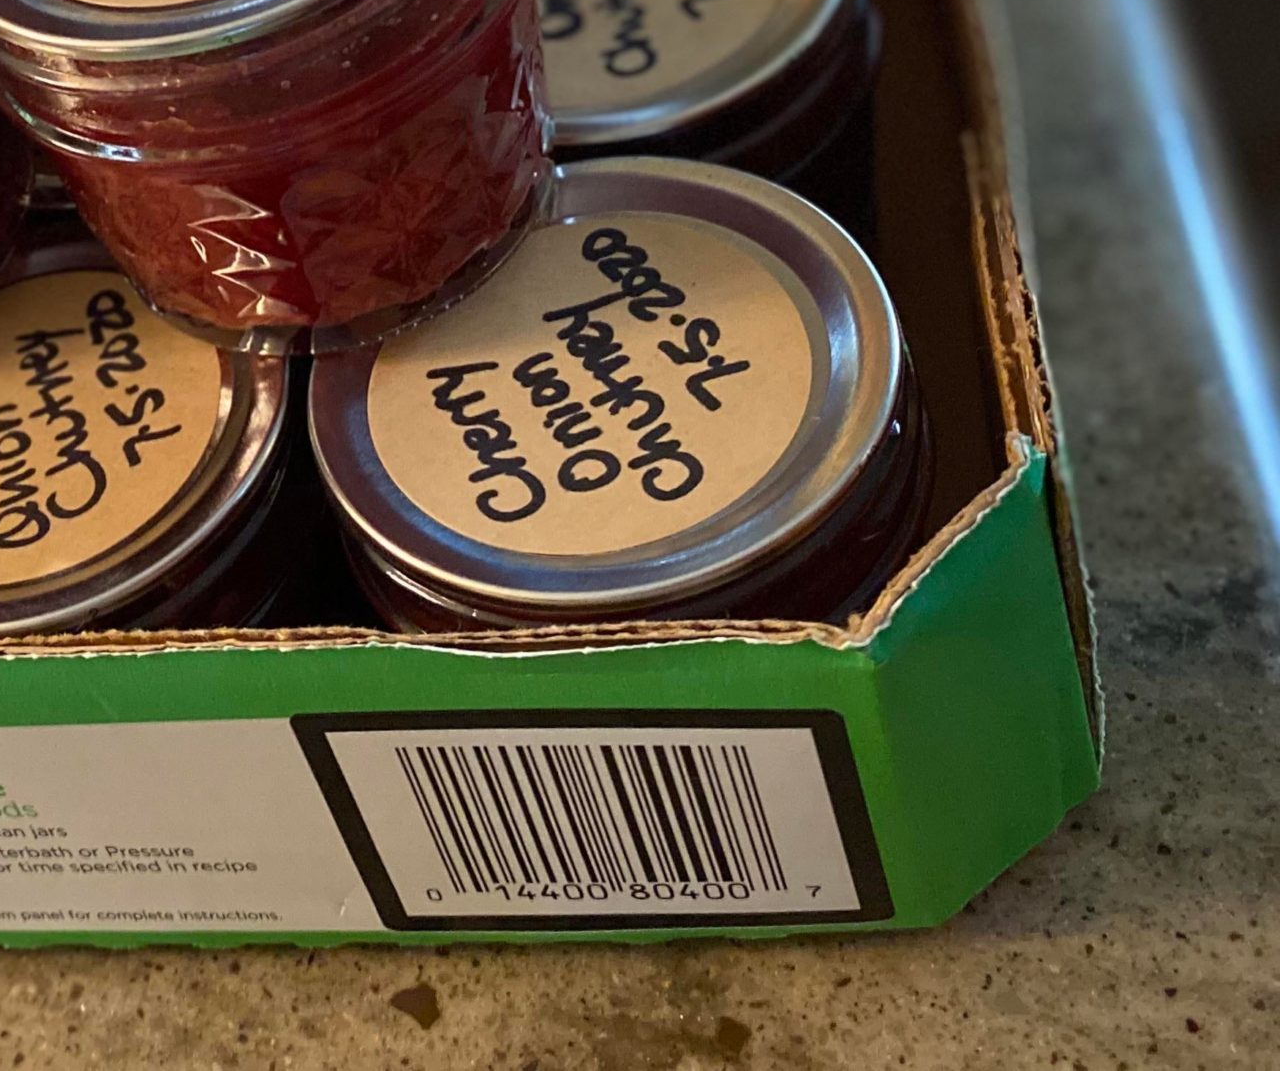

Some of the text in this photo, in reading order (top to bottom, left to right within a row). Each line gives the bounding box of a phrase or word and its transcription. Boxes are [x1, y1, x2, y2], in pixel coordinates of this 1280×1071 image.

[86, 289, 183, 467] 7.5.2020
[581, 229, 751, 411] 7.5.2020
[16, 327, 108, 519] Chutney
[426, 361, 546, 523] Cherry
[511, 352, 621, 492] Onion
[542, 291, 704, 502] Chutney
[18, 860, 65, 874] time
[68, 859, 162, 876] specified
[166, 859, 188, 873] in
[191, 859, 259, 875] recipe
[29, 823, 68, 840] jars
[77, 847, 99, 859] or
[105, 844, 195, 859] Pressure
[425, 882, 822, 903] 0 14400 80400 7
[19, 908, 65, 924] panel
[67, 908, 92, 921] for
[95, 907, 175, 924] complete
[177, 906, 284, 922] instructions.
